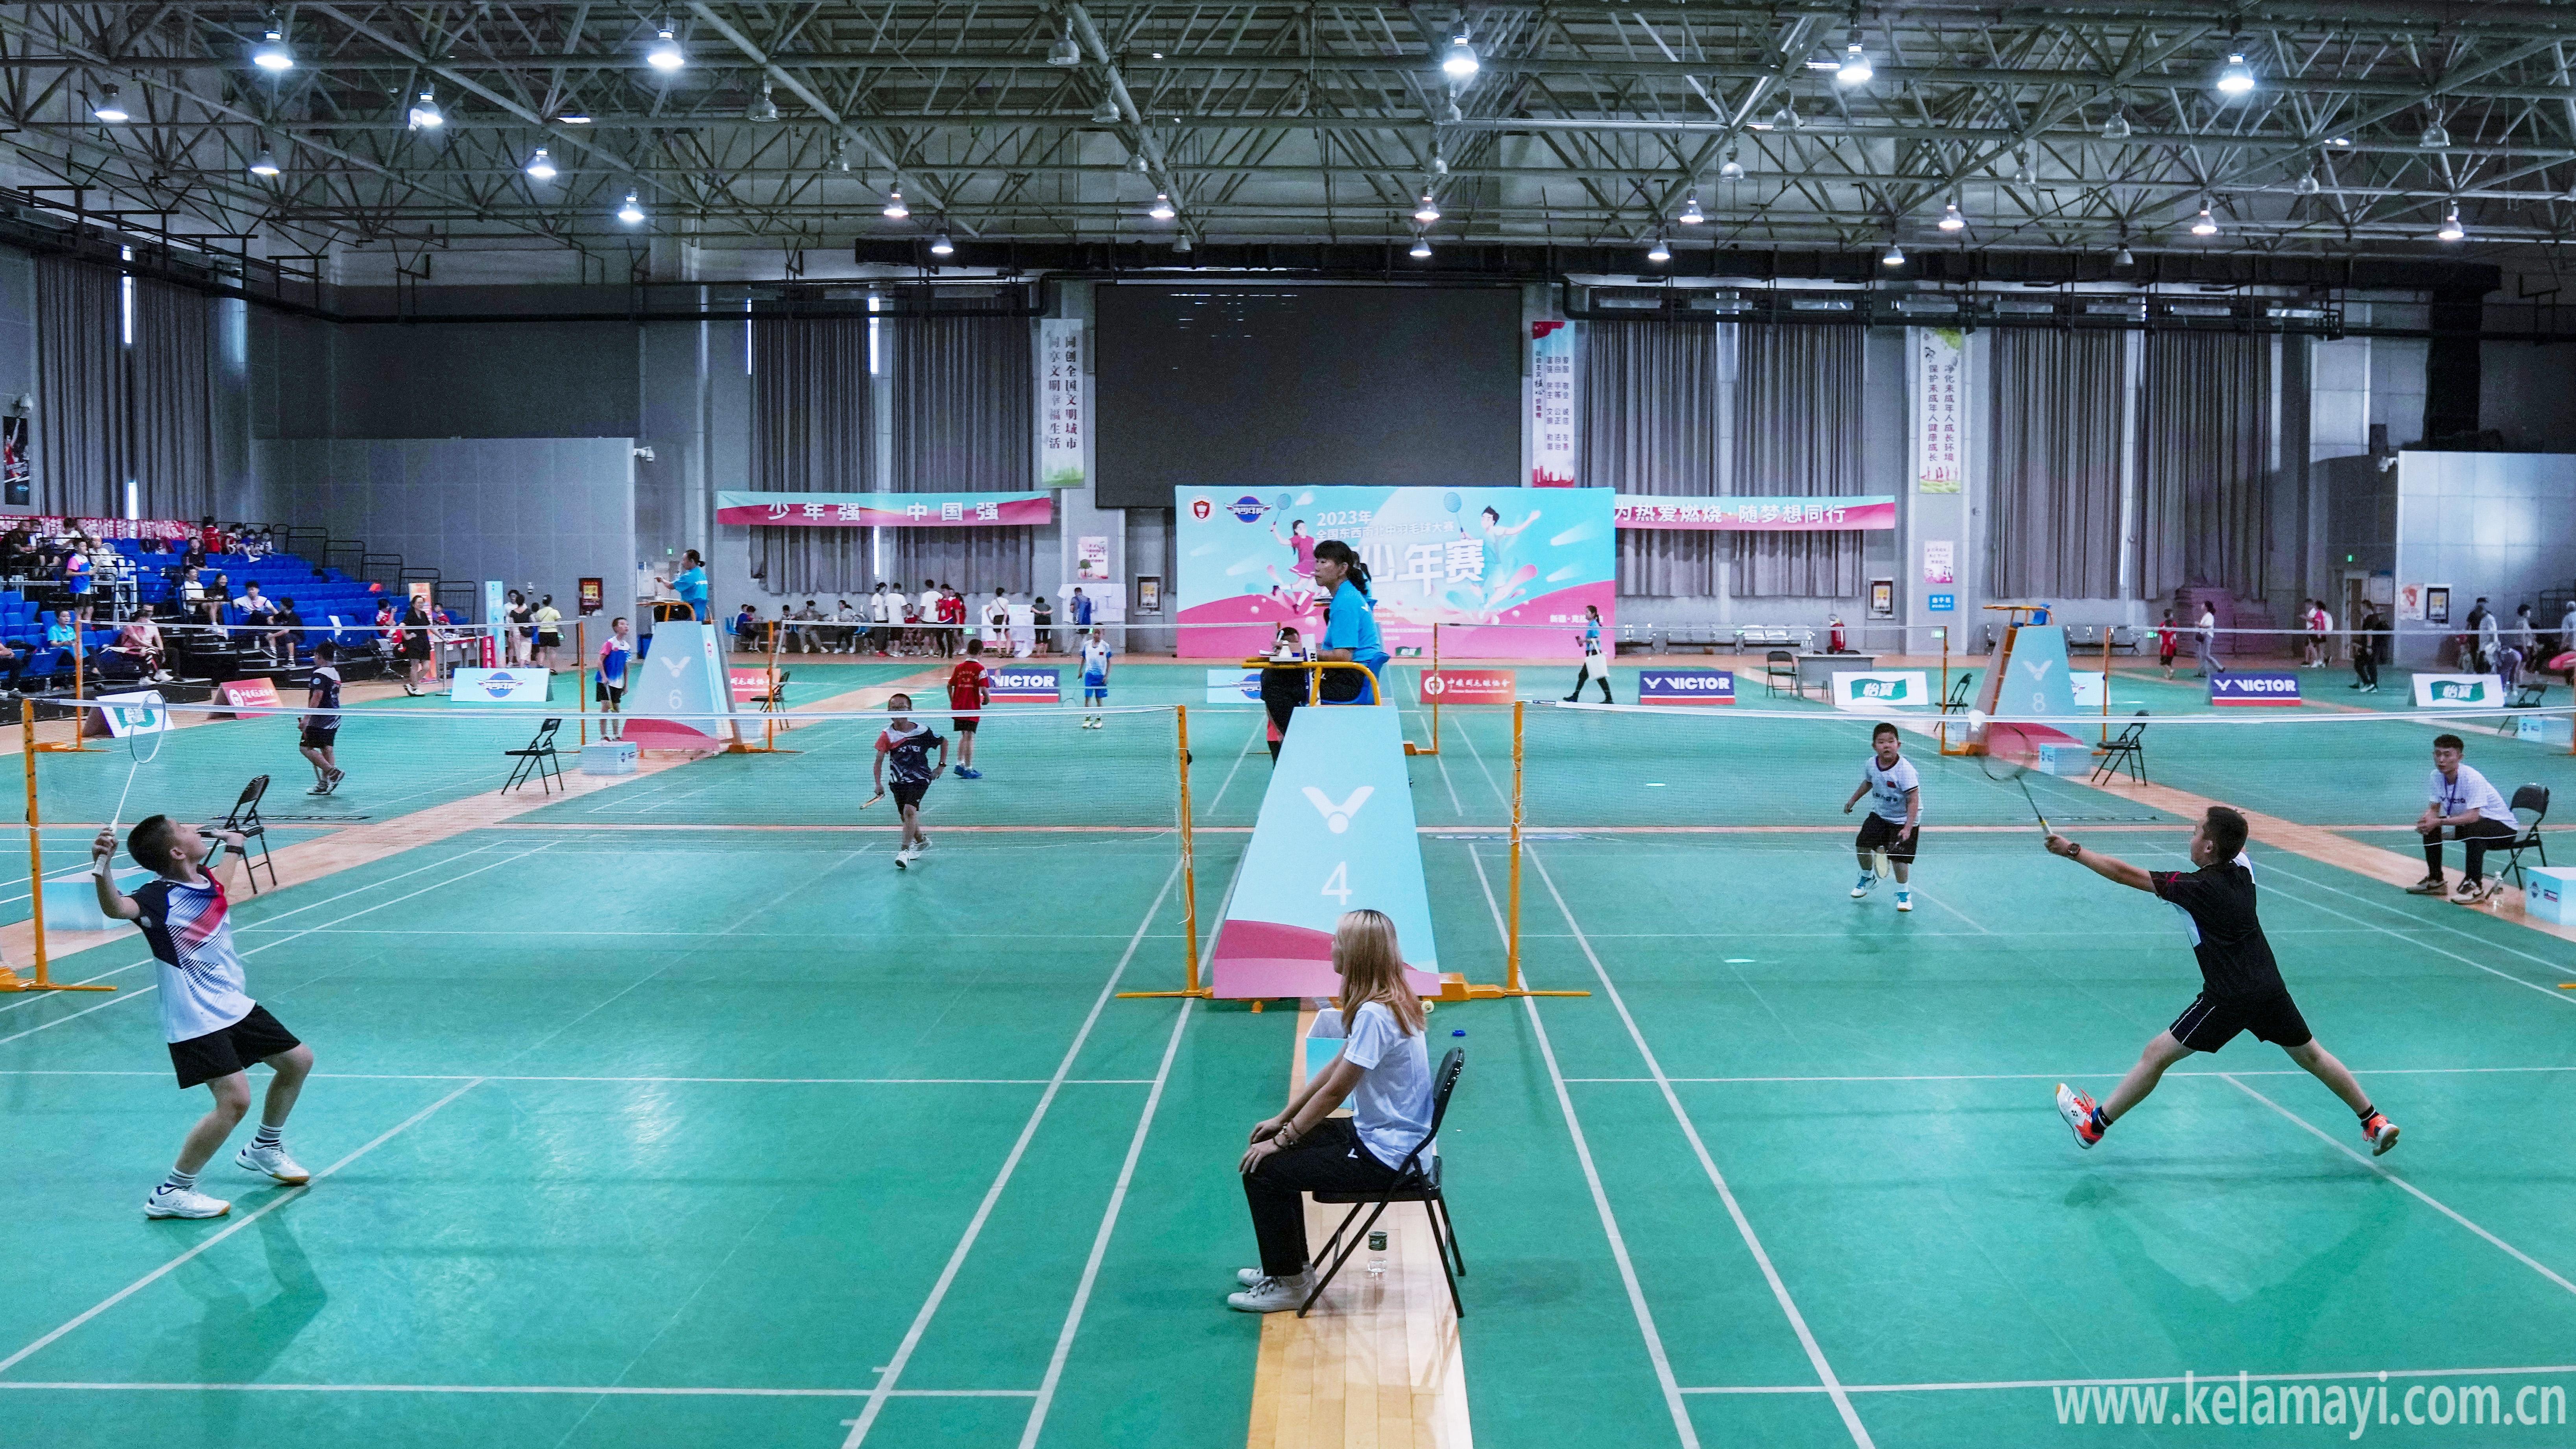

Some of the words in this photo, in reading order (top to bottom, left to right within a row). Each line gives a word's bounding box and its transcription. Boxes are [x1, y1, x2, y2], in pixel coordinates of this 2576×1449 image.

[768, 501, 860, 521] 少年强
[906, 501, 999, 521] 中国强
[1317, 510, 1372, 526] 2023年
[1316, 521, 1454, 540] 全国东西南北中羽毛球大赛
[1353, 539, 1485, 596] 少年赛
[989, 675, 1055, 687] VICTOR
[1664, 677, 1730, 690] VICTOR
[2234, 679, 2296, 692] VICTOR
[669, 689, 682, 709] 6
[2033, 692, 2045, 712] 8
[1321, 861, 1353, 906] 4
